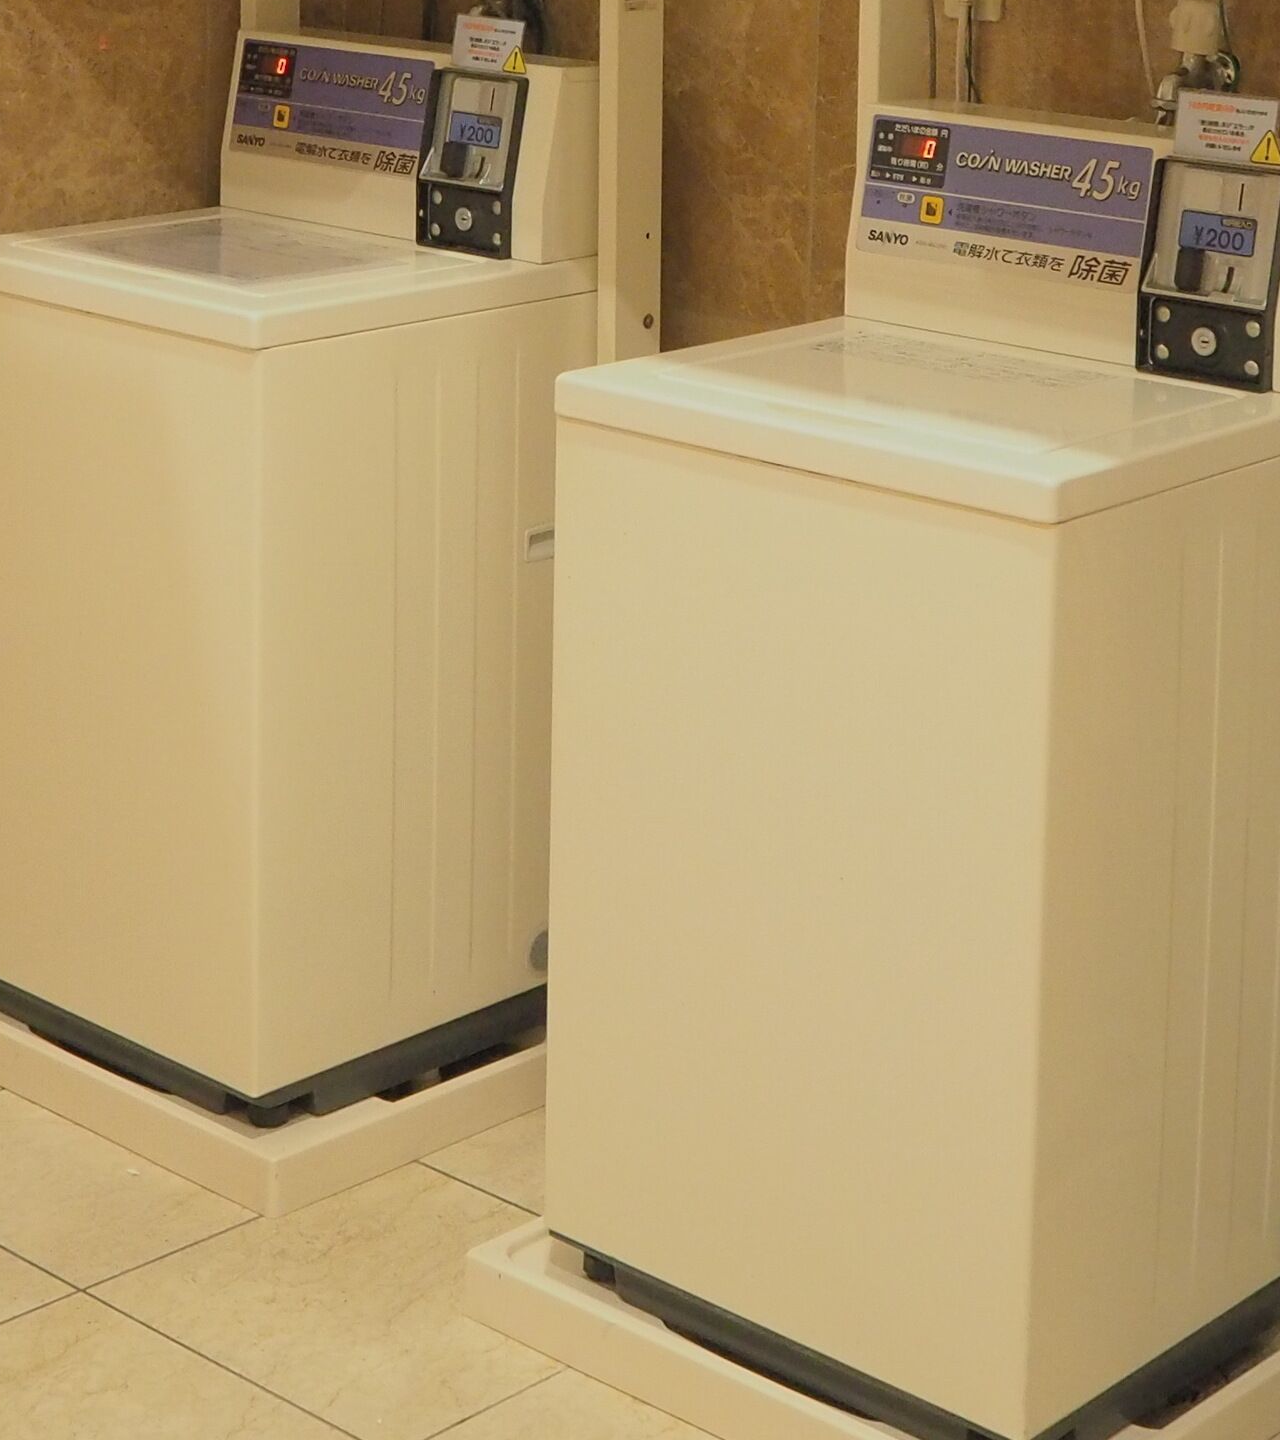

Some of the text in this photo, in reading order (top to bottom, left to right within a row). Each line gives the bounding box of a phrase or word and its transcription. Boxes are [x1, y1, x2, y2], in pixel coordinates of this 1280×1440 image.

[276, 58, 287, 75] 0
[333, 71, 380, 91] WASHER
[236, 134, 266, 148] SANYO
[459, 125, 494, 145] ¥200
[923, 140, 936, 158] 0
[373, 151, 418, 175] 除菌
[1004, 159, 1072, 182] WASHER
[868, 228, 909, 247] SANYO
[1193, 225, 1245, 251] ¥200
[952, 240, 1132, 287] 電解水で衣類を 除菌
